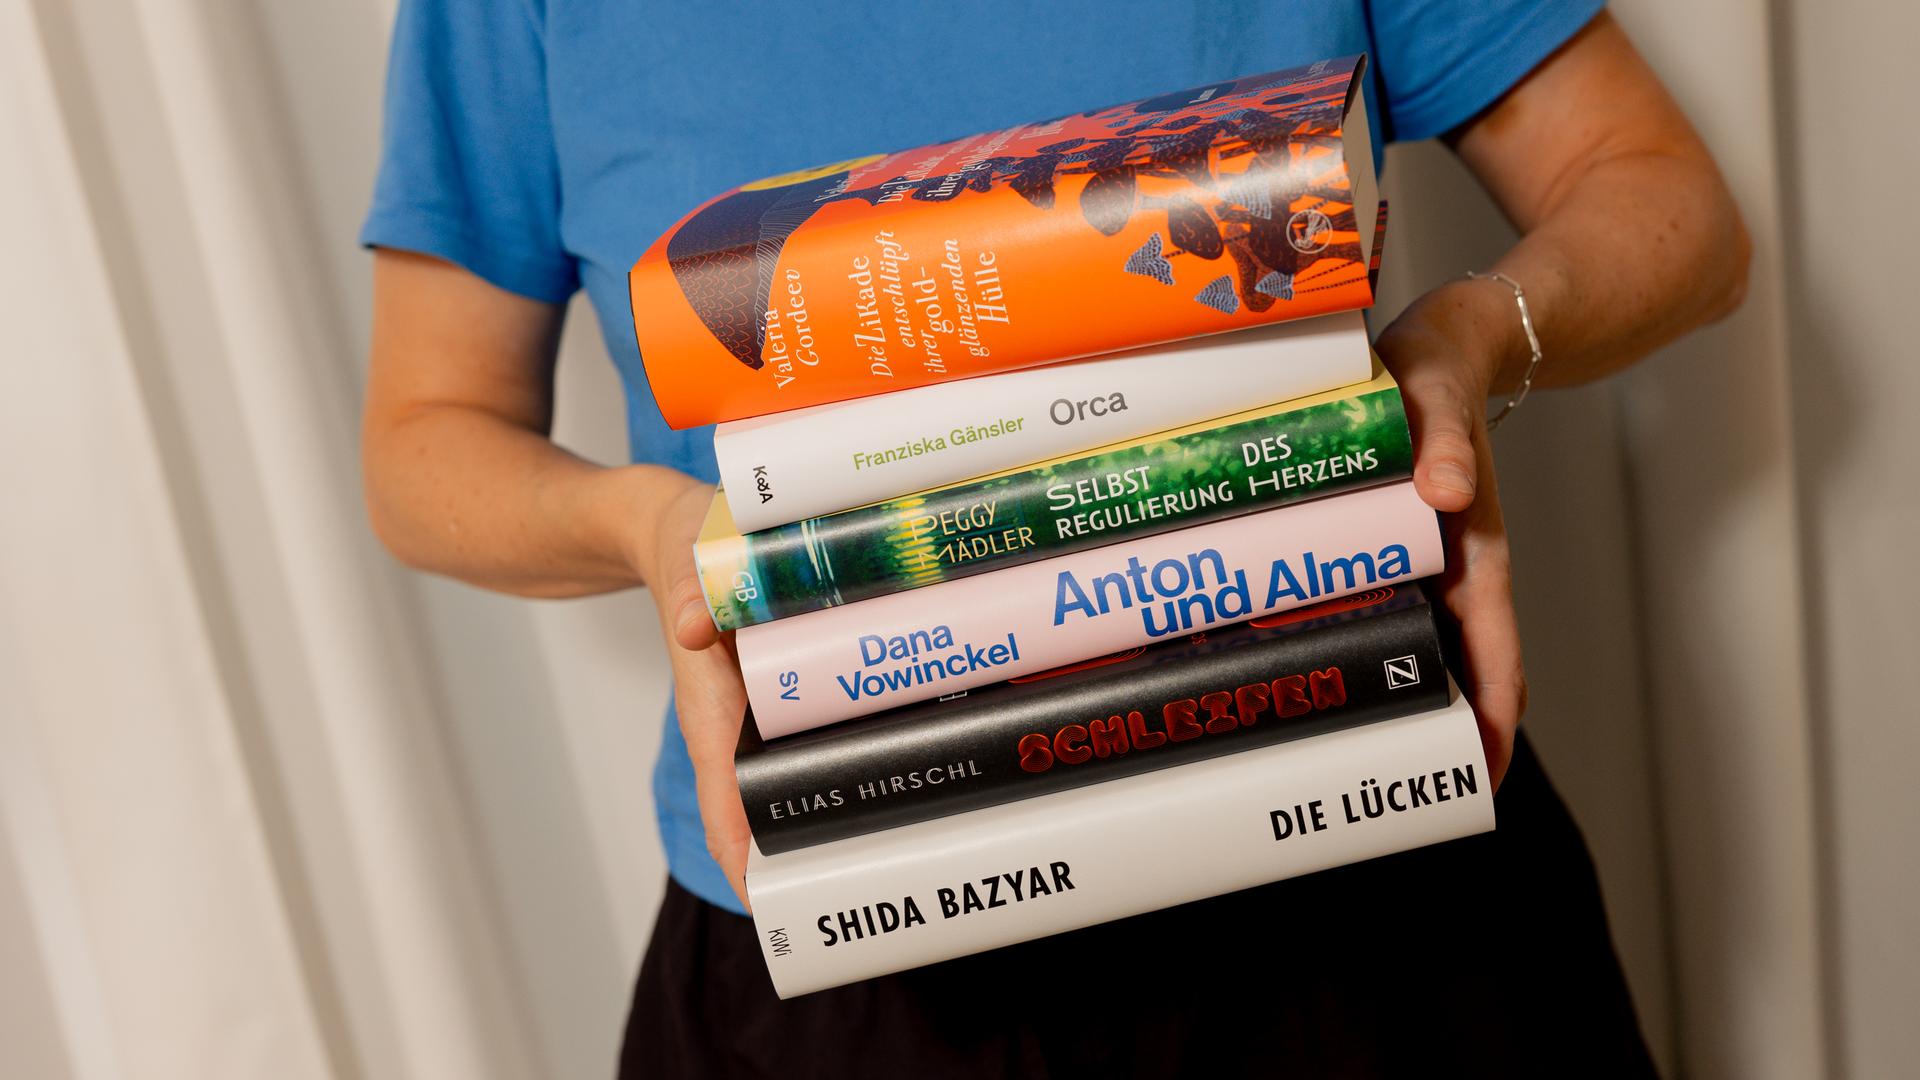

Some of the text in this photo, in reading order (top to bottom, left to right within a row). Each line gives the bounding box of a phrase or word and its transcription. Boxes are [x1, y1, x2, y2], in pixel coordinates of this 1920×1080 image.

[785, 268, 820, 367] Gordeev
[874, 230, 916, 348] entschlüpft
[912, 266, 955, 374] ihrer gold-
[941, 238, 990, 358] glänzenden
[973, 251, 1010, 325] Hülle
[761, 307, 796, 389] Valeria
[868, 345, 894, 378] Die
[1050, 391, 1128, 426] Orca
[853, 416, 1025, 471] Franziska Gänsler
[1242, 434, 1291, 467] DES
[1248, 448, 1379, 496] HERZENS
[910, 500, 996, 541] PEGGY
[1045, 465, 1150, 511] SELBST
[1055, 480, 1234, 539] REGULIERUNG
[918, 526, 1036, 570] MÄDLER
[733, 571, 757, 602] GB
[1053, 548, 1228, 626] Anton
[1141, 543, 1412, 638] und Alma
[837, 632, 1020, 701] Vowinckel
[858, 624, 954, 667] Dana
[1018, 666, 1347, 773] SCHLEIFEN
[769, 759, 982, 820] ELIAS HIRSCHL
[1269, 764, 1478, 841] DIE LÜCKEN
[817, 861, 1075, 946] SHIDA BAZYAR
